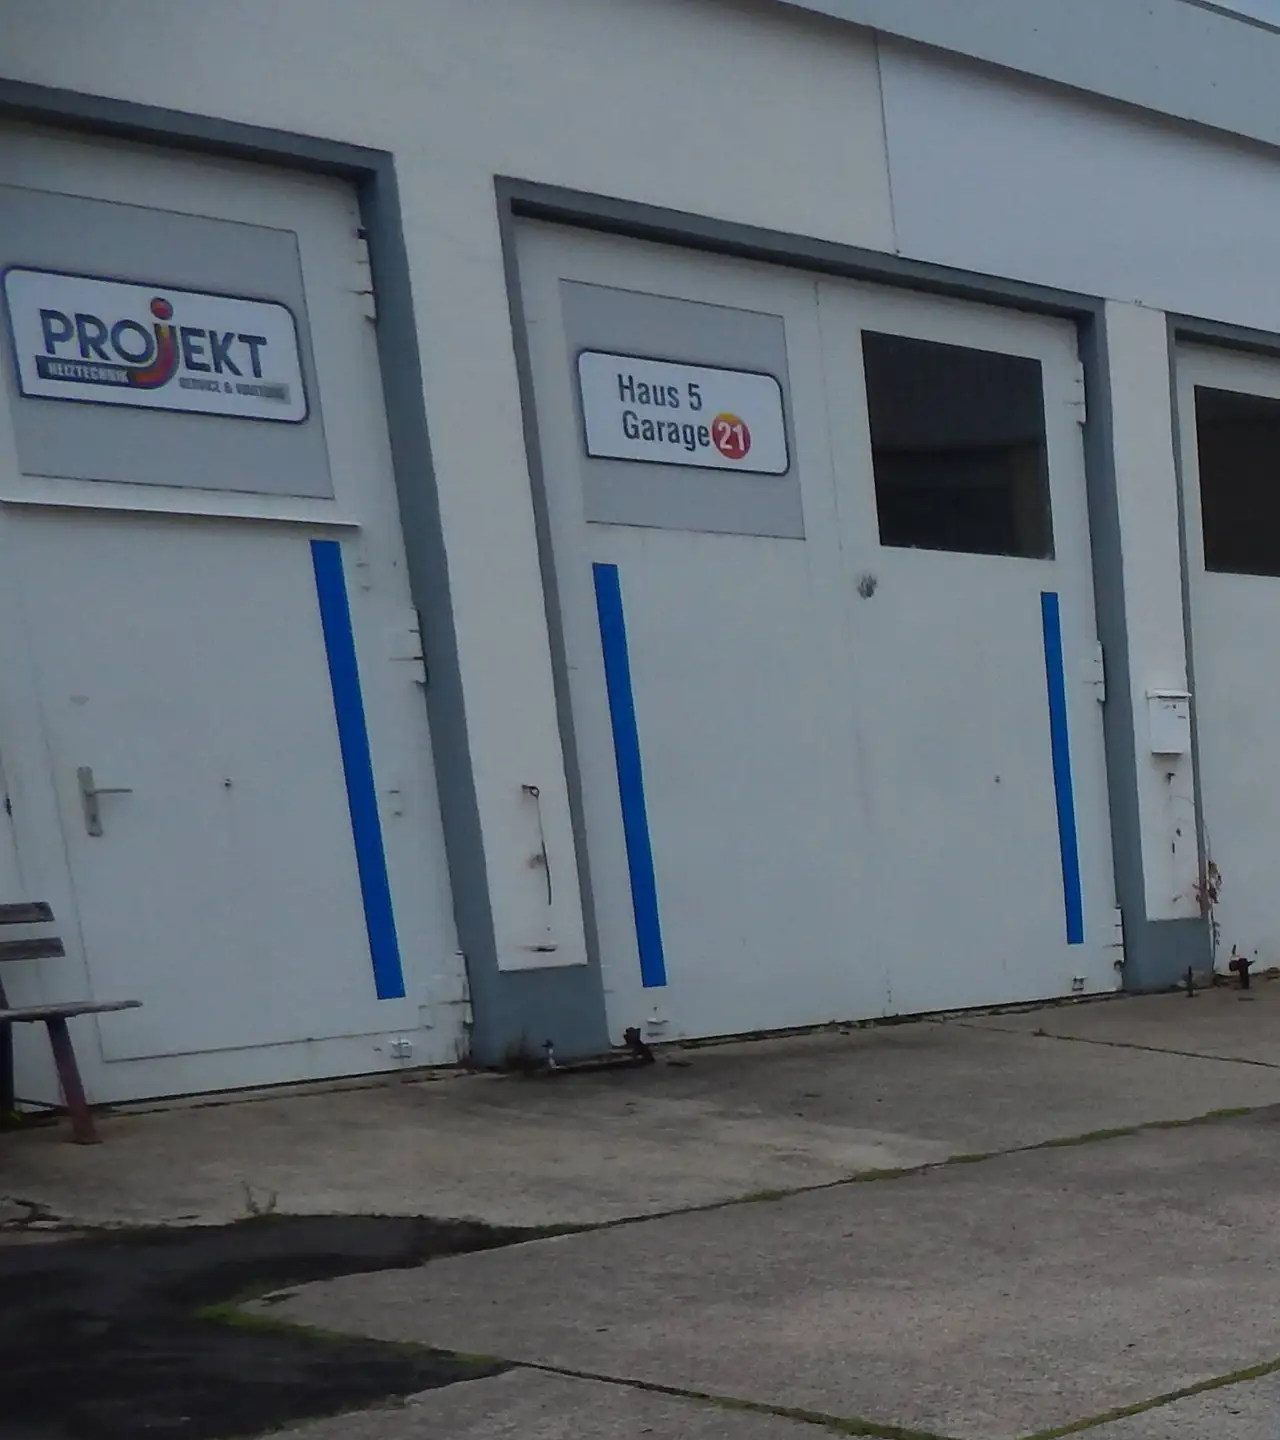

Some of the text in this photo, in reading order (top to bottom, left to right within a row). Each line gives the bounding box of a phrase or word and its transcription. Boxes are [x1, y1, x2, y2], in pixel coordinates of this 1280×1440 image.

[617, 374, 703, 411] Haus 5
[622, 410, 746, 451] Garage 21
